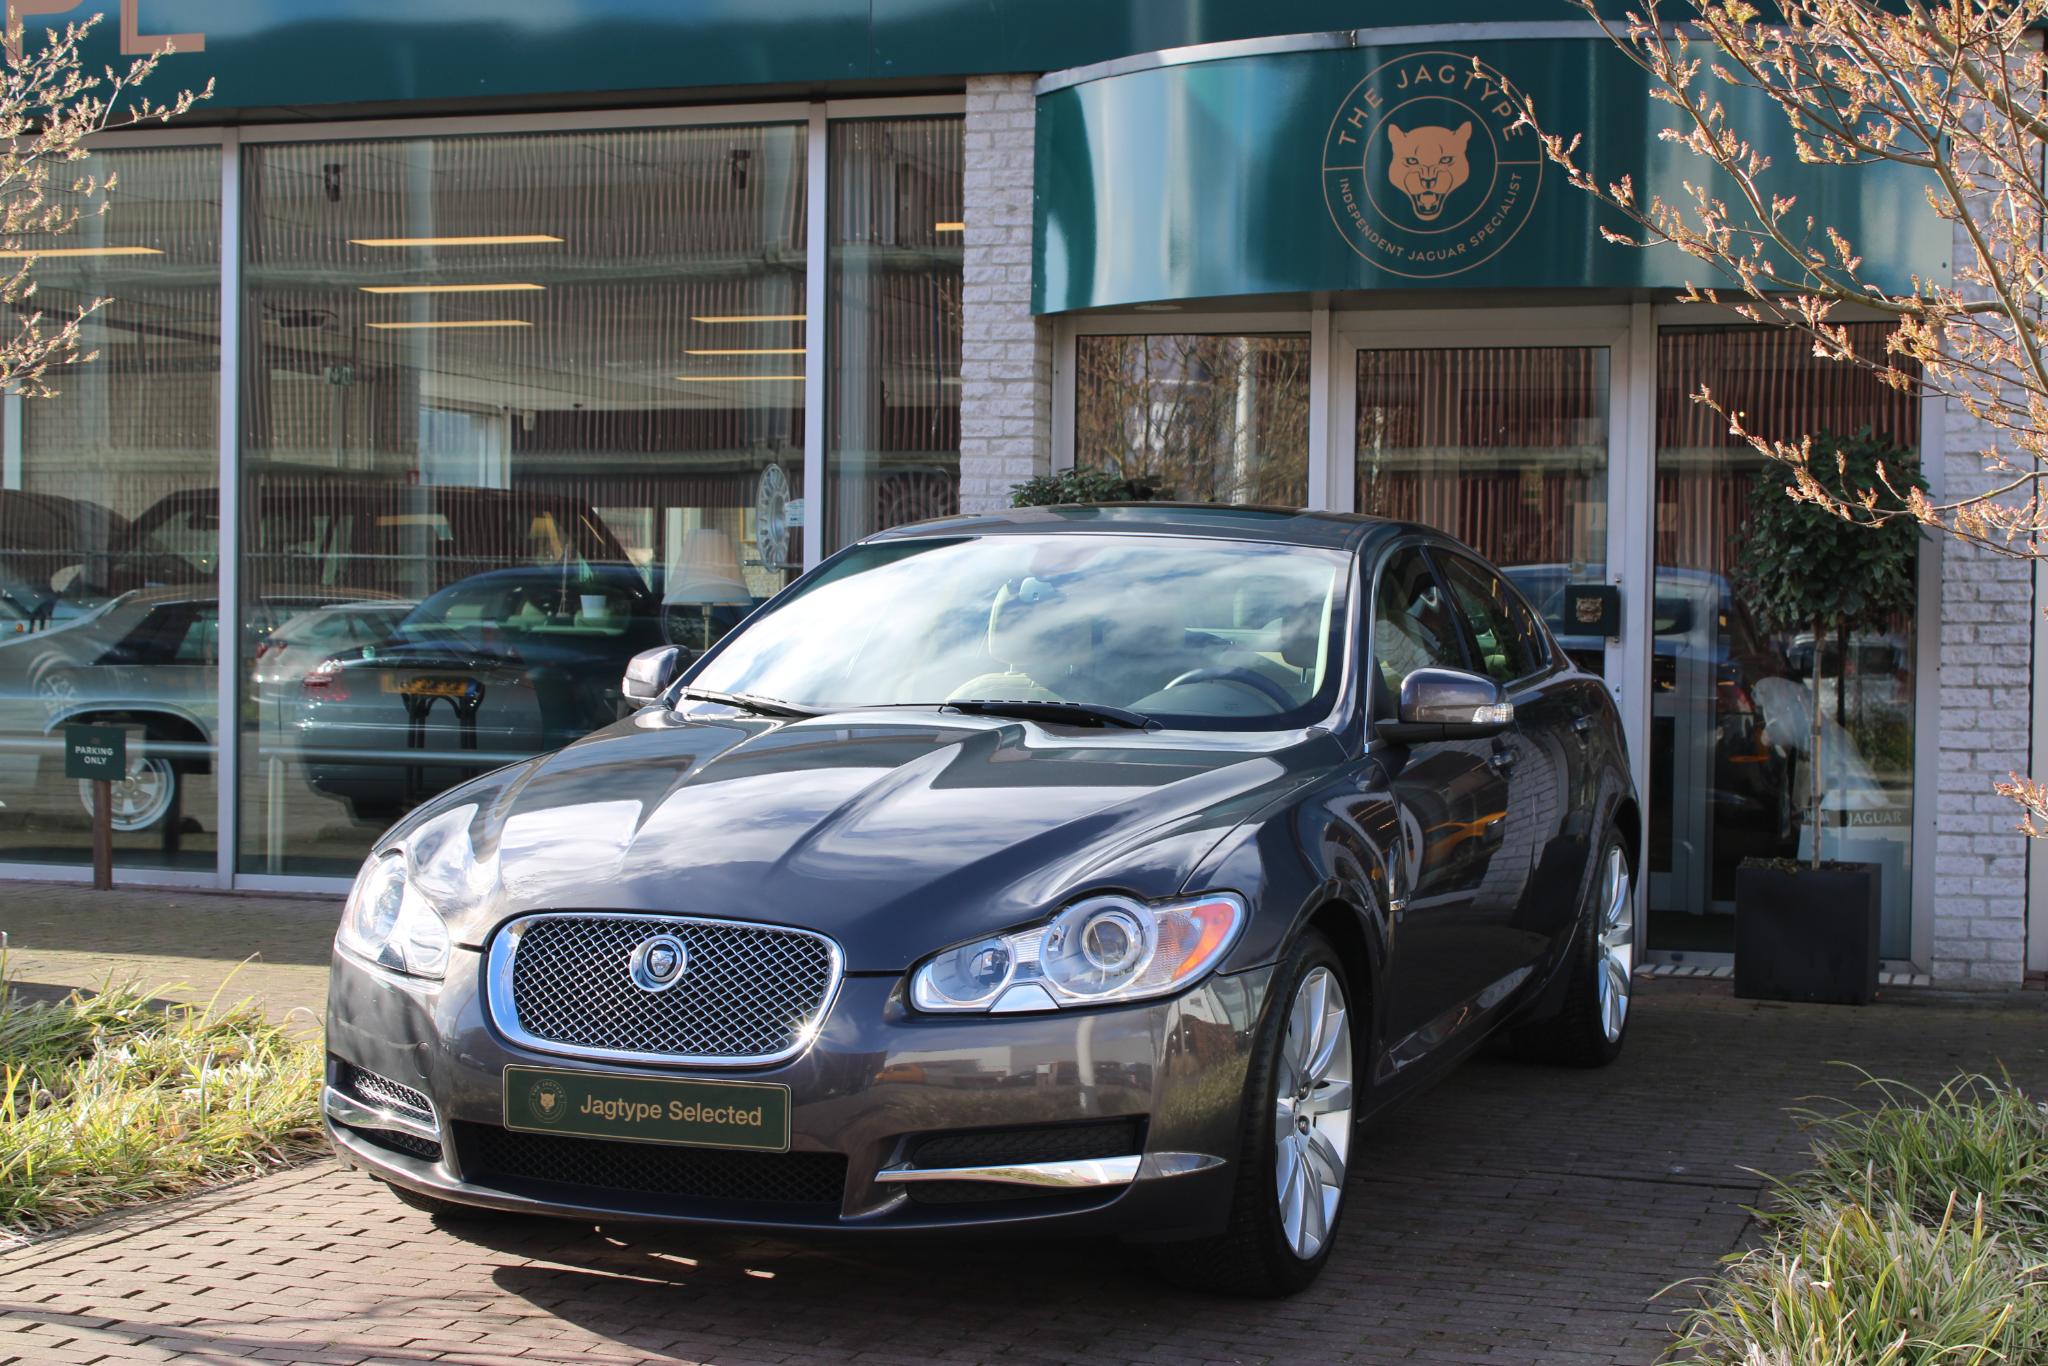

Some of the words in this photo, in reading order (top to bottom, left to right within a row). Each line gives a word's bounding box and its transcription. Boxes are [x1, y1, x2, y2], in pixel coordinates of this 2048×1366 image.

[1339, 88, 1384, 145] THE
[1397, 65, 1523, 141] JAGTYPE
[1339, 177, 1404, 257] INDEPENDENT
[1408, 243, 1466, 261] JAGUAR
[1470, 173, 1522, 247] SPECIALIST
[75, 746, 113, 755] PARKING
[84, 756, 107, 765] ONLY
[1848, 811, 1902, 826] JAGUAR
[580, 1094, 662, 1122] Jagtype
[668, 1101, 762, 1126] Selected
